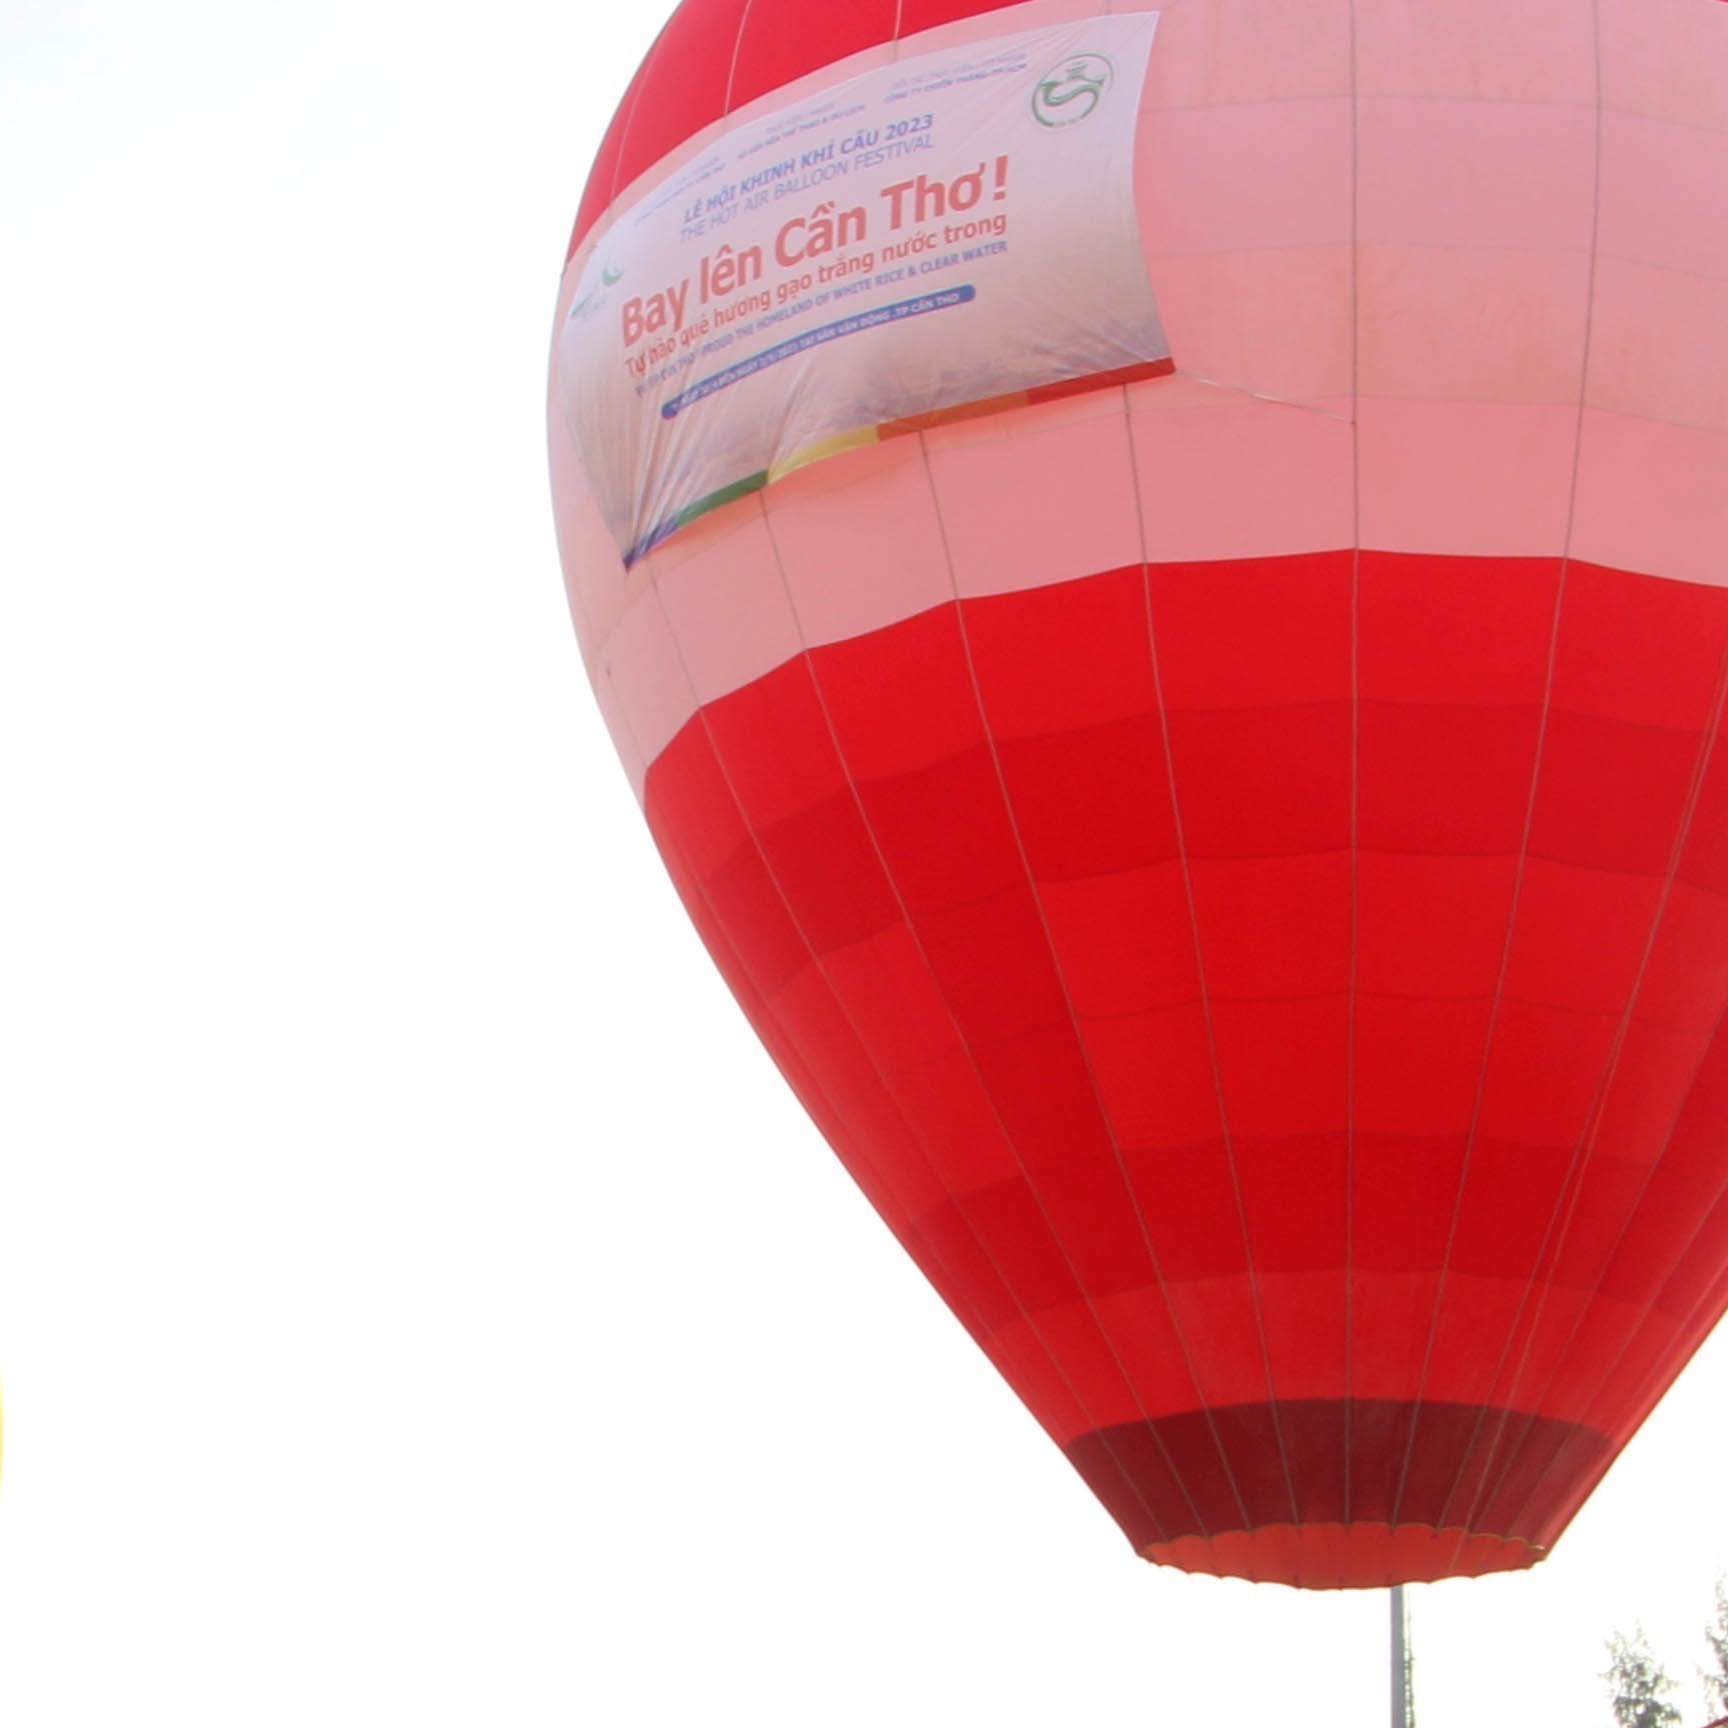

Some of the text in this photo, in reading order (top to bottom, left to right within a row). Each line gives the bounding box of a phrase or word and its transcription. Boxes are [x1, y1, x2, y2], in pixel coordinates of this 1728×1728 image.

[680, 219, 705, 242] THE
[710, 201, 738, 229] HOT
[744, 189, 769, 211] AIR
[774, 158, 848, 200] BALLOON
[854, 134, 935, 170] FESTIVAL
[706, 185, 736, 212] HỘI
[739, 157, 795, 194] KHINH
[801, 140, 834, 168] KHÍ
[885, 113, 933, 140] 2023
[622, 278, 689, 348] Bay
[700, 243, 762, 304] lên
[774, 200, 866, 267] Cần
[649, 337, 676, 365] hào
[680, 313, 709, 348] quê
[714, 289, 771, 328] hương
[777, 274, 812, 304] gạo
[882, 231, 937, 262] nước
[944, 214, 1007, 243] trong
[834, 278, 872, 298] WHITE
[875, 268, 904, 286] RICE
[920, 253, 960, 273] CLEAR
[962, 240, 1007, 261] WATER
